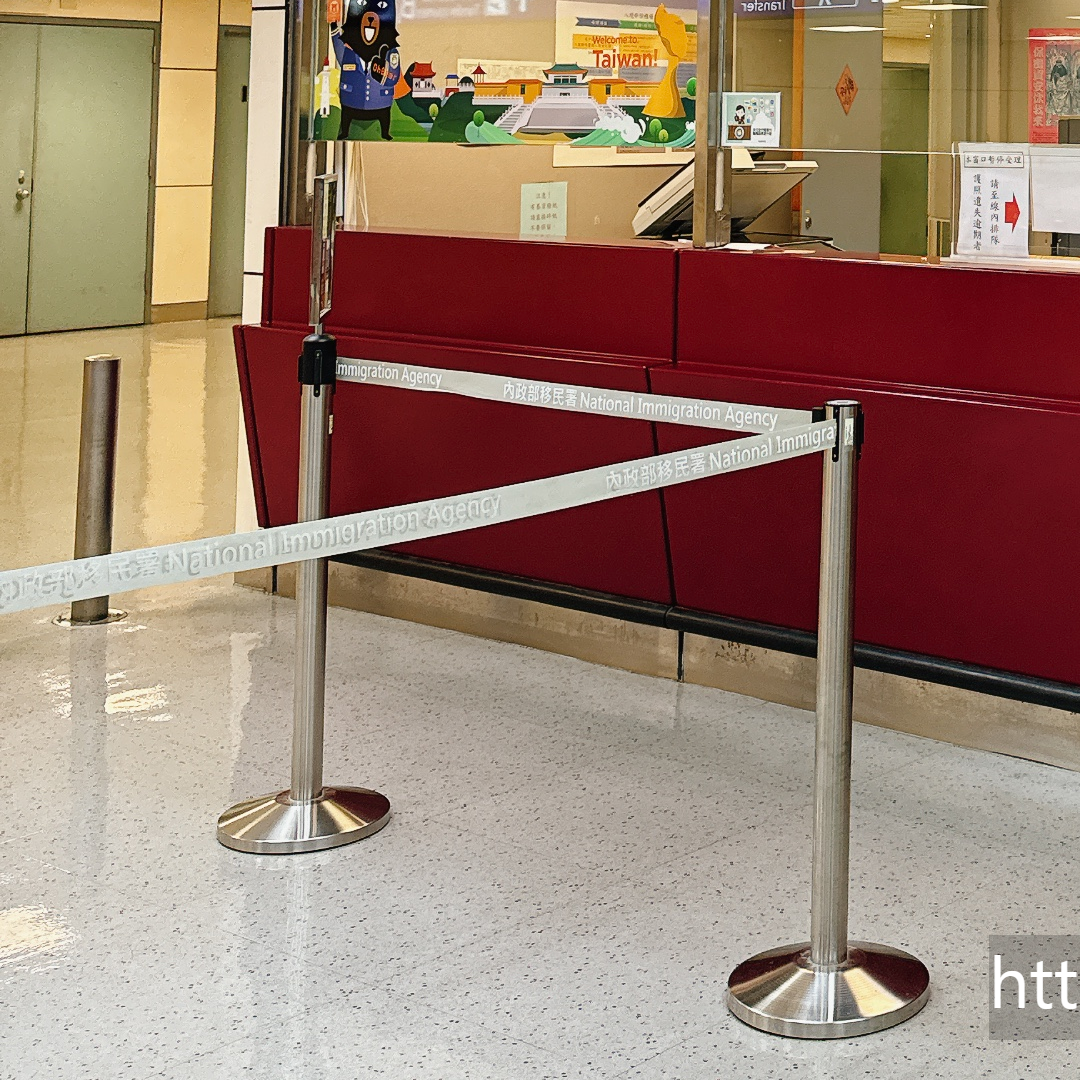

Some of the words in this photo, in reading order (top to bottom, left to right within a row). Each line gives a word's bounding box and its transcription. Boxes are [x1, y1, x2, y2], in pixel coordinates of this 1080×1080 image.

[592, 35, 627, 45] Welcome
[593, 49, 658, 68] Taiwan!
[966, 156, 1021, 164] 本窗口暫停受理
[990, 179, 1000, 245] 請至線內排隊
[336, 360, 399, 382] Immigration
[401, 364, 442, 388] Agency
[503, 380, 577, 409] 內政部移民署
[580, 391, 634, 413] National
[638, 396, 720, 421] Immigration
[725, 406, 778, 430] Agency
[606, 452, 706, 492] 內政部移民署
[709, 437, 773, 471] National
[167, 533, 273, 569] National
[281, 510, 419, 554] Immigration
[424, 494, 502, 528] Agency
